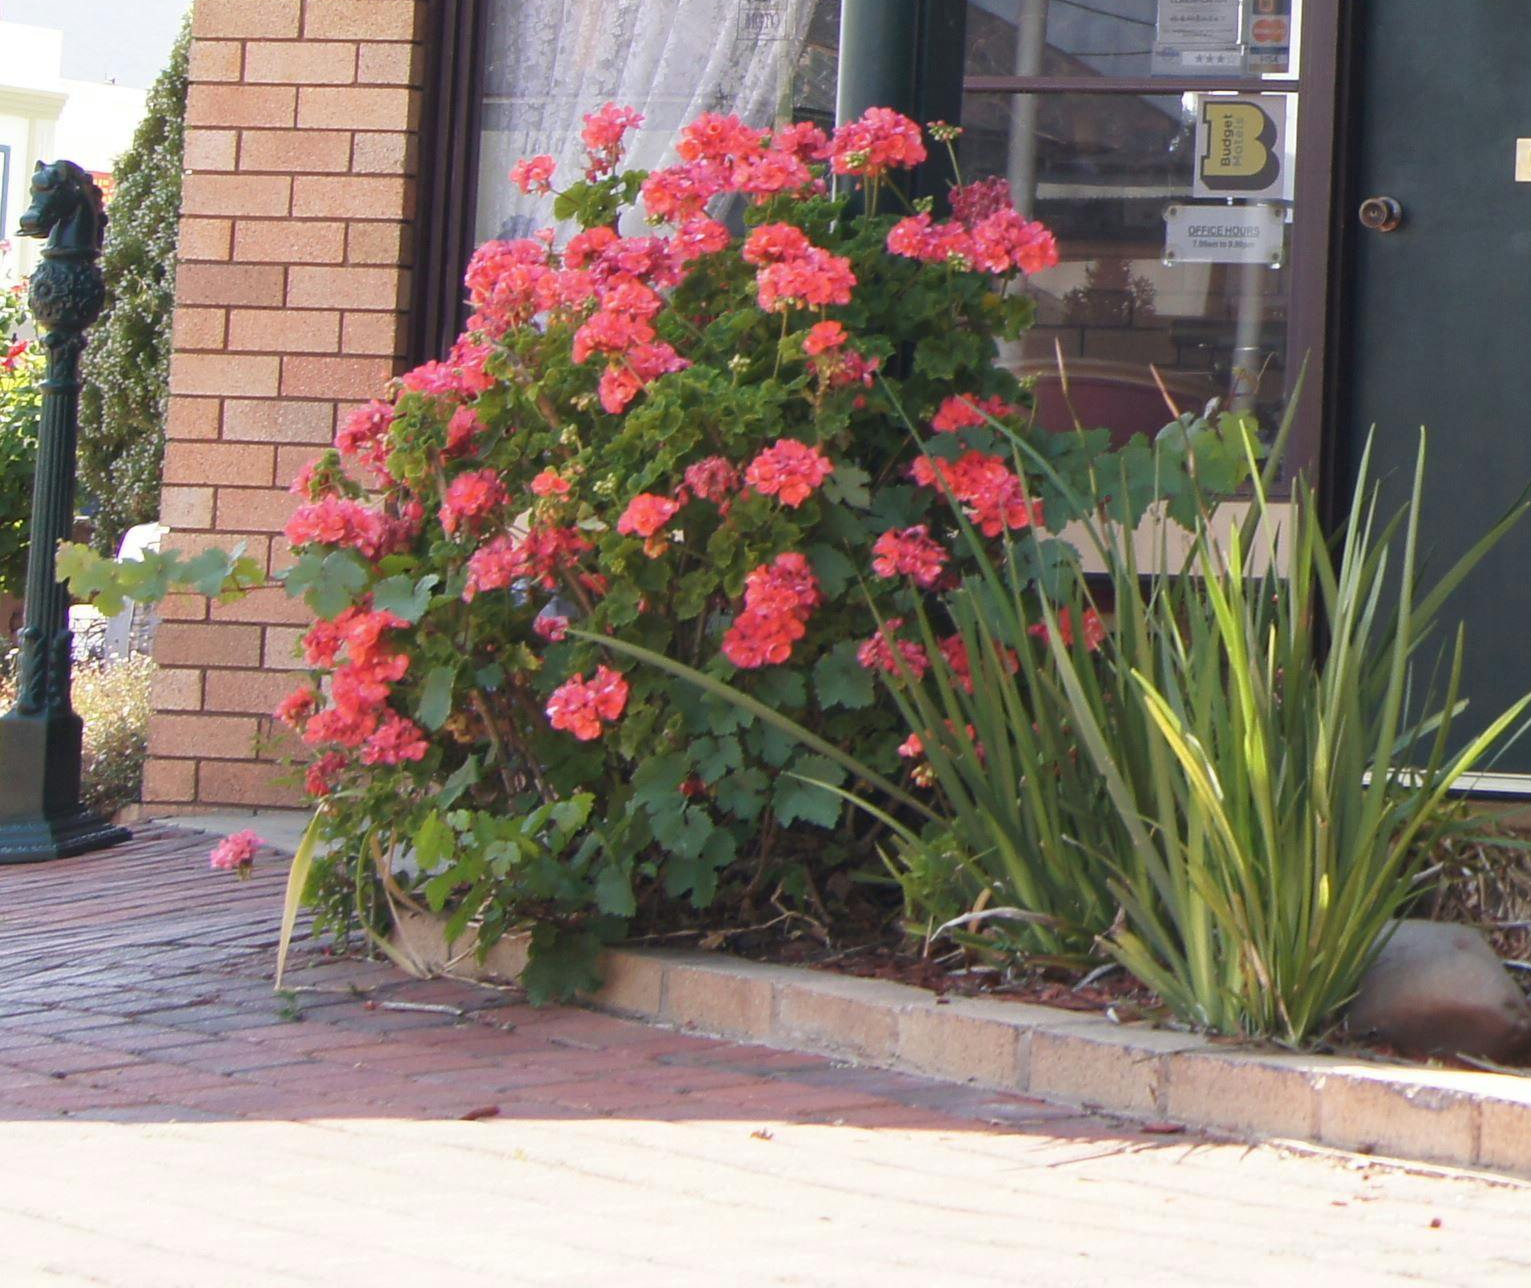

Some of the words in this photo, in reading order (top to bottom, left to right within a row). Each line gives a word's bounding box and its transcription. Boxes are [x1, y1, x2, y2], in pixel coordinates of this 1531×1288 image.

[1221, 114, 1234, 166] Budget
[1188, 225, 1223, 237] OFFICE
[1225, 226, 1260, 237] HOURS
